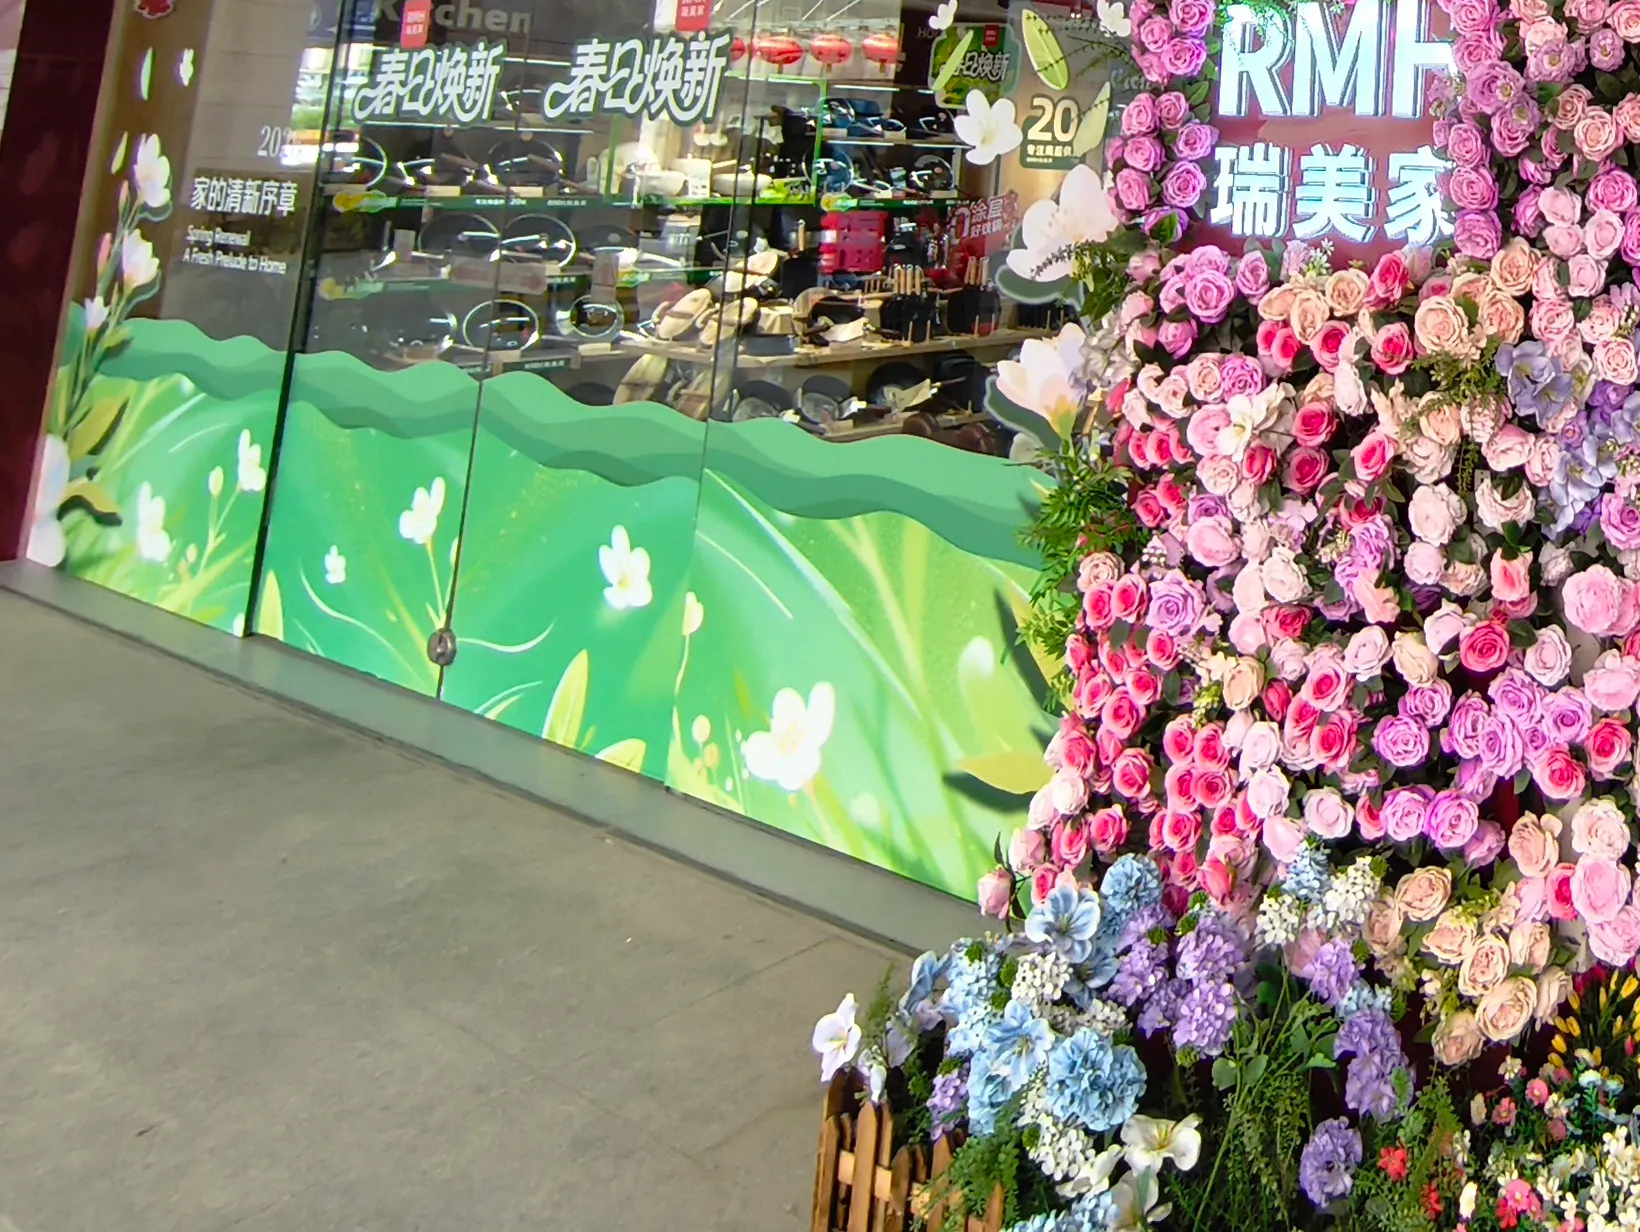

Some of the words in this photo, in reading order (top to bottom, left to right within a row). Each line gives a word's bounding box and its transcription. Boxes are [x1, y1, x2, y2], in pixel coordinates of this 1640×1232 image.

[353, 41, 504, 123] 春日焕新
[543, 29, 731, 121] 春日焕新
[1028, 96, 1079, 142] 20
[190, 175, 299, 217] 家的清新序章
[1210, 141, 1458, 245] 瑞美家
[186, 224, 213, 246] Spring
[182, 247, 191, 262] A
[191, 248, 214, 266] Fresh
[215, 250, 247, 271] Prelude
[248, 255, 259, 271] to
[259, 256, 287, 275] Home
